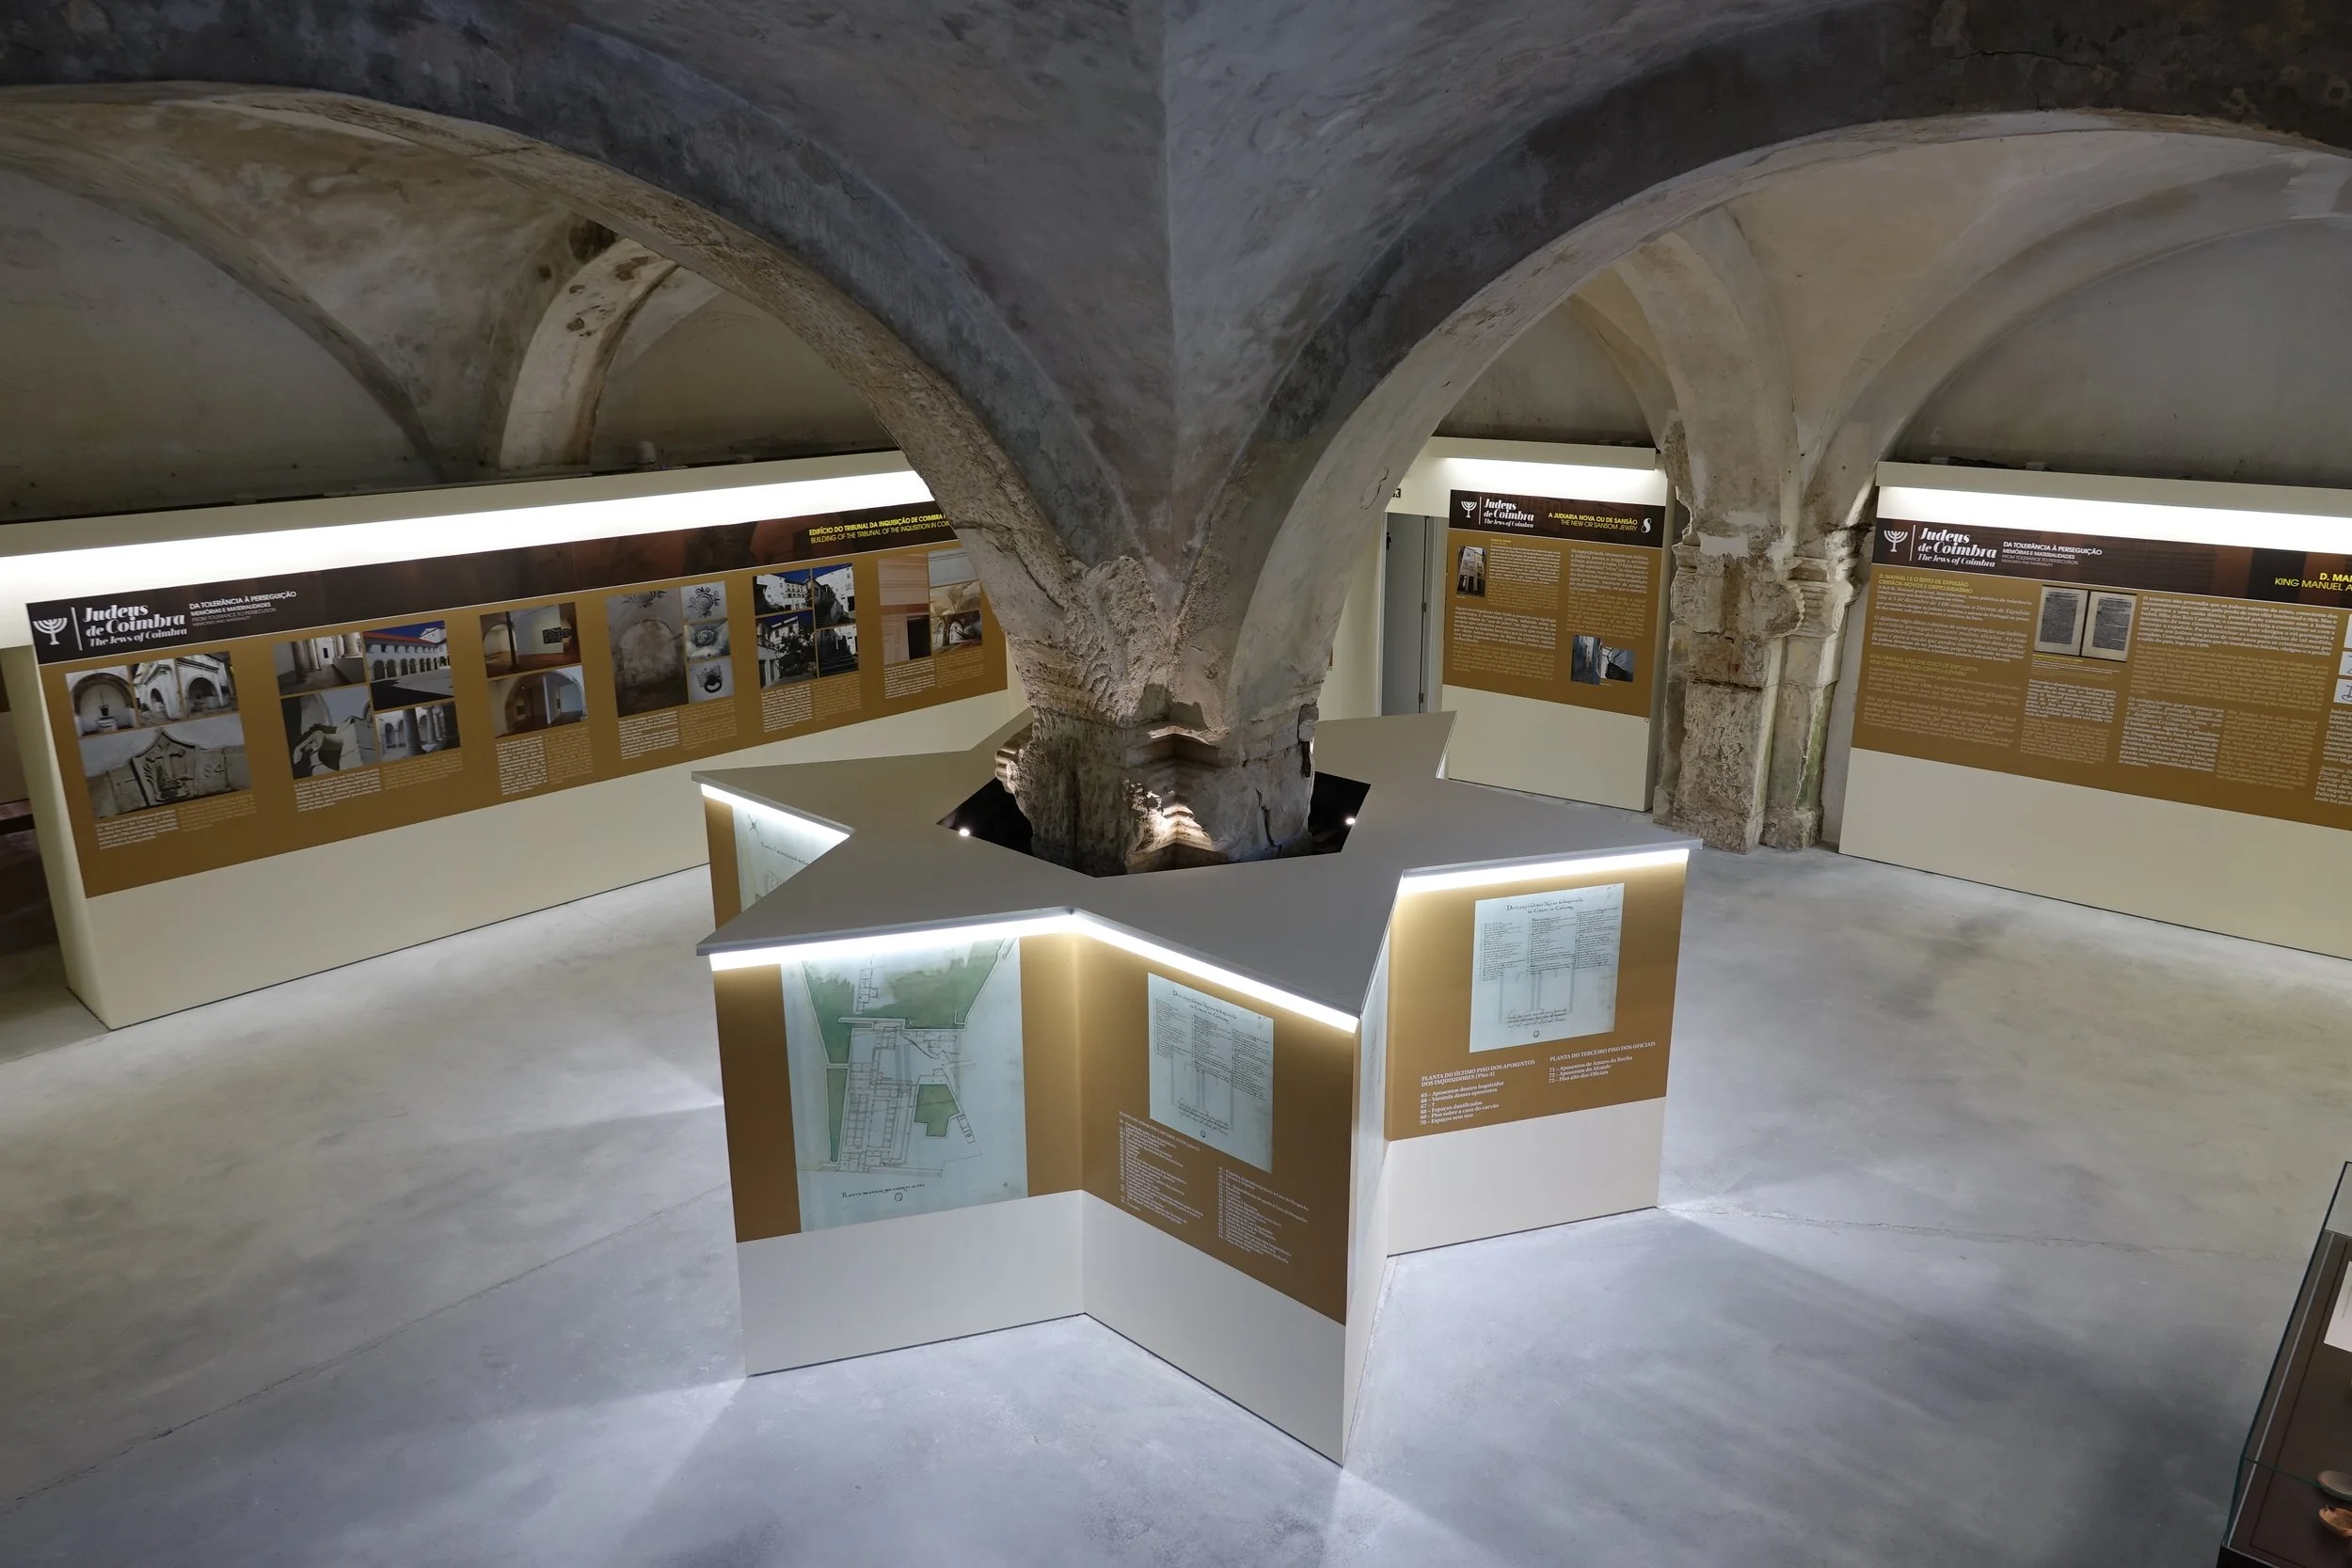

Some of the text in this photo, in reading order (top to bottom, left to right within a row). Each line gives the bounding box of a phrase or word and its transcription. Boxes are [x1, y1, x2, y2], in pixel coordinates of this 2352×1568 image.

[1484, 499, 1517, 511] Judeus
[1494, 510, 1534, 521] Coimbra
[809, 525, 834, 535] EDIFÍCIO
[844, 523, 869, 531] TRIBUNAL
[879, 517, 910, 528] INQUISIÇÃO
[918, 515, 943, 523] COIMBRA
[811, 533, 837, 544] BUILDING
[857, 529, 881, 538] TRIBUNAL
[900, 522, 930, 532] INQUISITION
[1919, 528, 1970, 544] Judeus
[1918, 541, 1997, 559] de Coimbra
[2003, 547, 2029, 556] MEMÓRIAS
[2034, 550, 2074, 560] MATERIALIDADES
[2013, 542, 2051, 551] TOLERÂNCIA
[2058, 546, 2103, 557] PERSEGUIÇÃO
[1933, 554, 1950, 563] Jews
[1952, 556, 1961, 565] of
[1961, 557, 1995, 567] Coimbra
[1879, 579, 1923, 589] CRISTÃOS-NOVOS
[1928, 583, 1973, 594] CRIPTOJUDAÍSMO
[1919, 576, 1933, 584] ÉDITO
[1943, 578, 1969, 587] EXPULSÃO
[2275, 578, 2299, 586] KING
[2301, 580, 2343, 591] MANUEL
[200, 597, 243, 609] TOLERÂNCIA
[244, 595, 250, 604] À
[250, 591, 296, 603] PERSEGUIÇÃO
[83, 604, 149, 623] Judeus
[191, 607, 222, 616] MEMÓRIAS
[227, 602, 271, 612] MATERIALIDADES
[86, 625, 104, 637] de
[105, 611, 185, 633] Coimbra
[89, 635, 108, 647] The
[109, 634, 134, 644] Jews
[134, 631, 145, 643] of
[146, 627, 187, 640] Coimbra
[1454, 1069, 1476, 1077] ÚLTIMO
[1502, 1060, 1535, 1069] APOSENTOS
[1559, 1069, 1585, 1077] Aposentos
[1435, 1074, 1474, 1085] INQUISIDORES
[1432, 1088, 1458, 1097] Aposentos
[1478, 1081, 1504, 1089] Inquisidor
[1471, 1088, 1497, 1097] aposentos
[1454, 1101, 1483, 1109] danificados
[1431, 1117, 1452, 1125] Espaços
